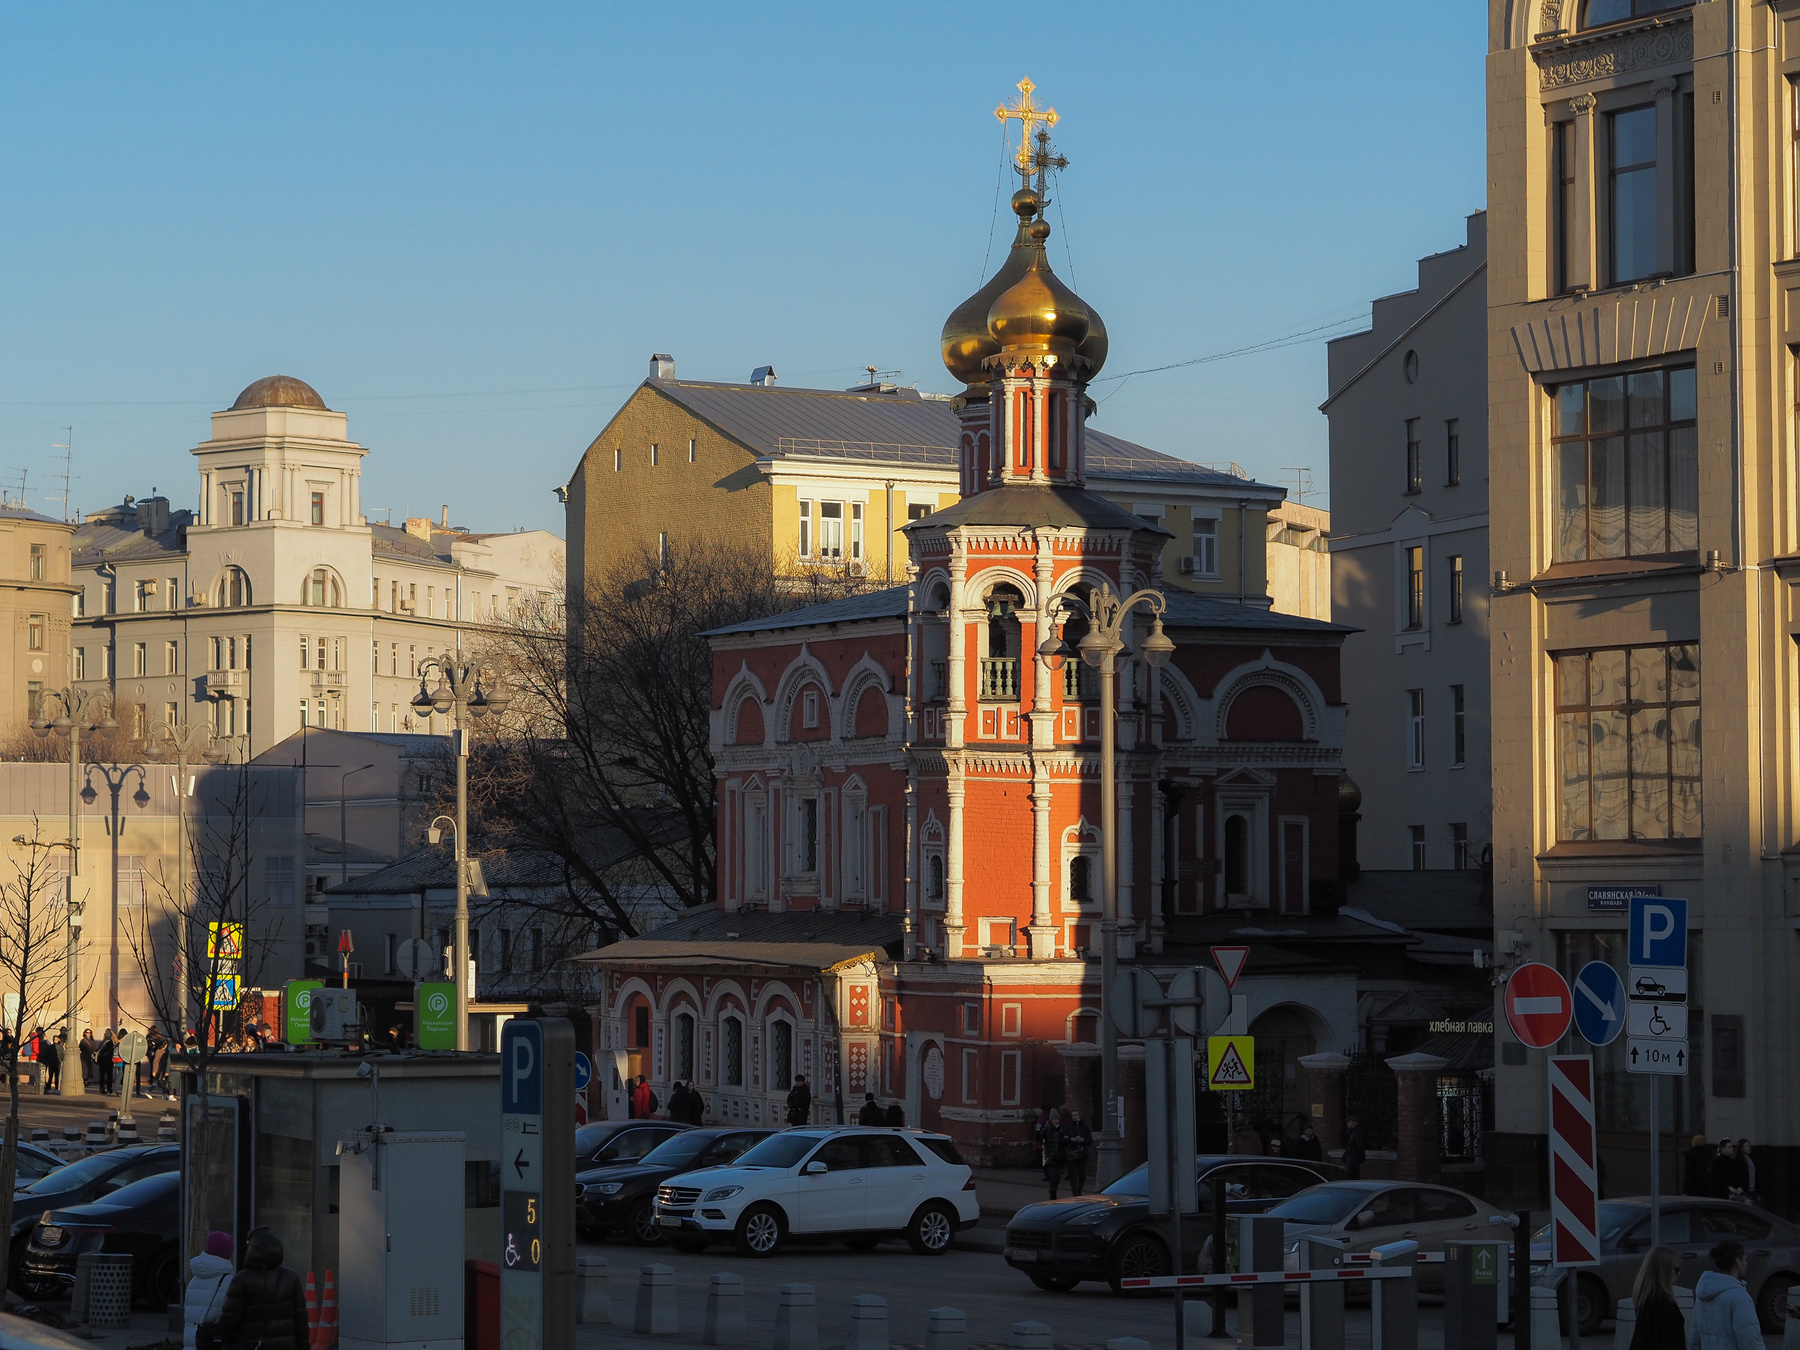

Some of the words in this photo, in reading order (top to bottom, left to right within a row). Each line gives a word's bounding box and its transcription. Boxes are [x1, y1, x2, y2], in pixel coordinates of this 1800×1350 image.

[1588, 890, 1633, 900] СЛАВЯНСКАЯ
[1643, 904, 1675, 959] P
[1429, 1018, 1466, 1033] хлебная
[1467, 1021, 1494, 1034] лавка
[512, 1036, 534, 1104] P
[527, 1198, 536, 1224] 5
[531, 1238, 541, 1265] 0
